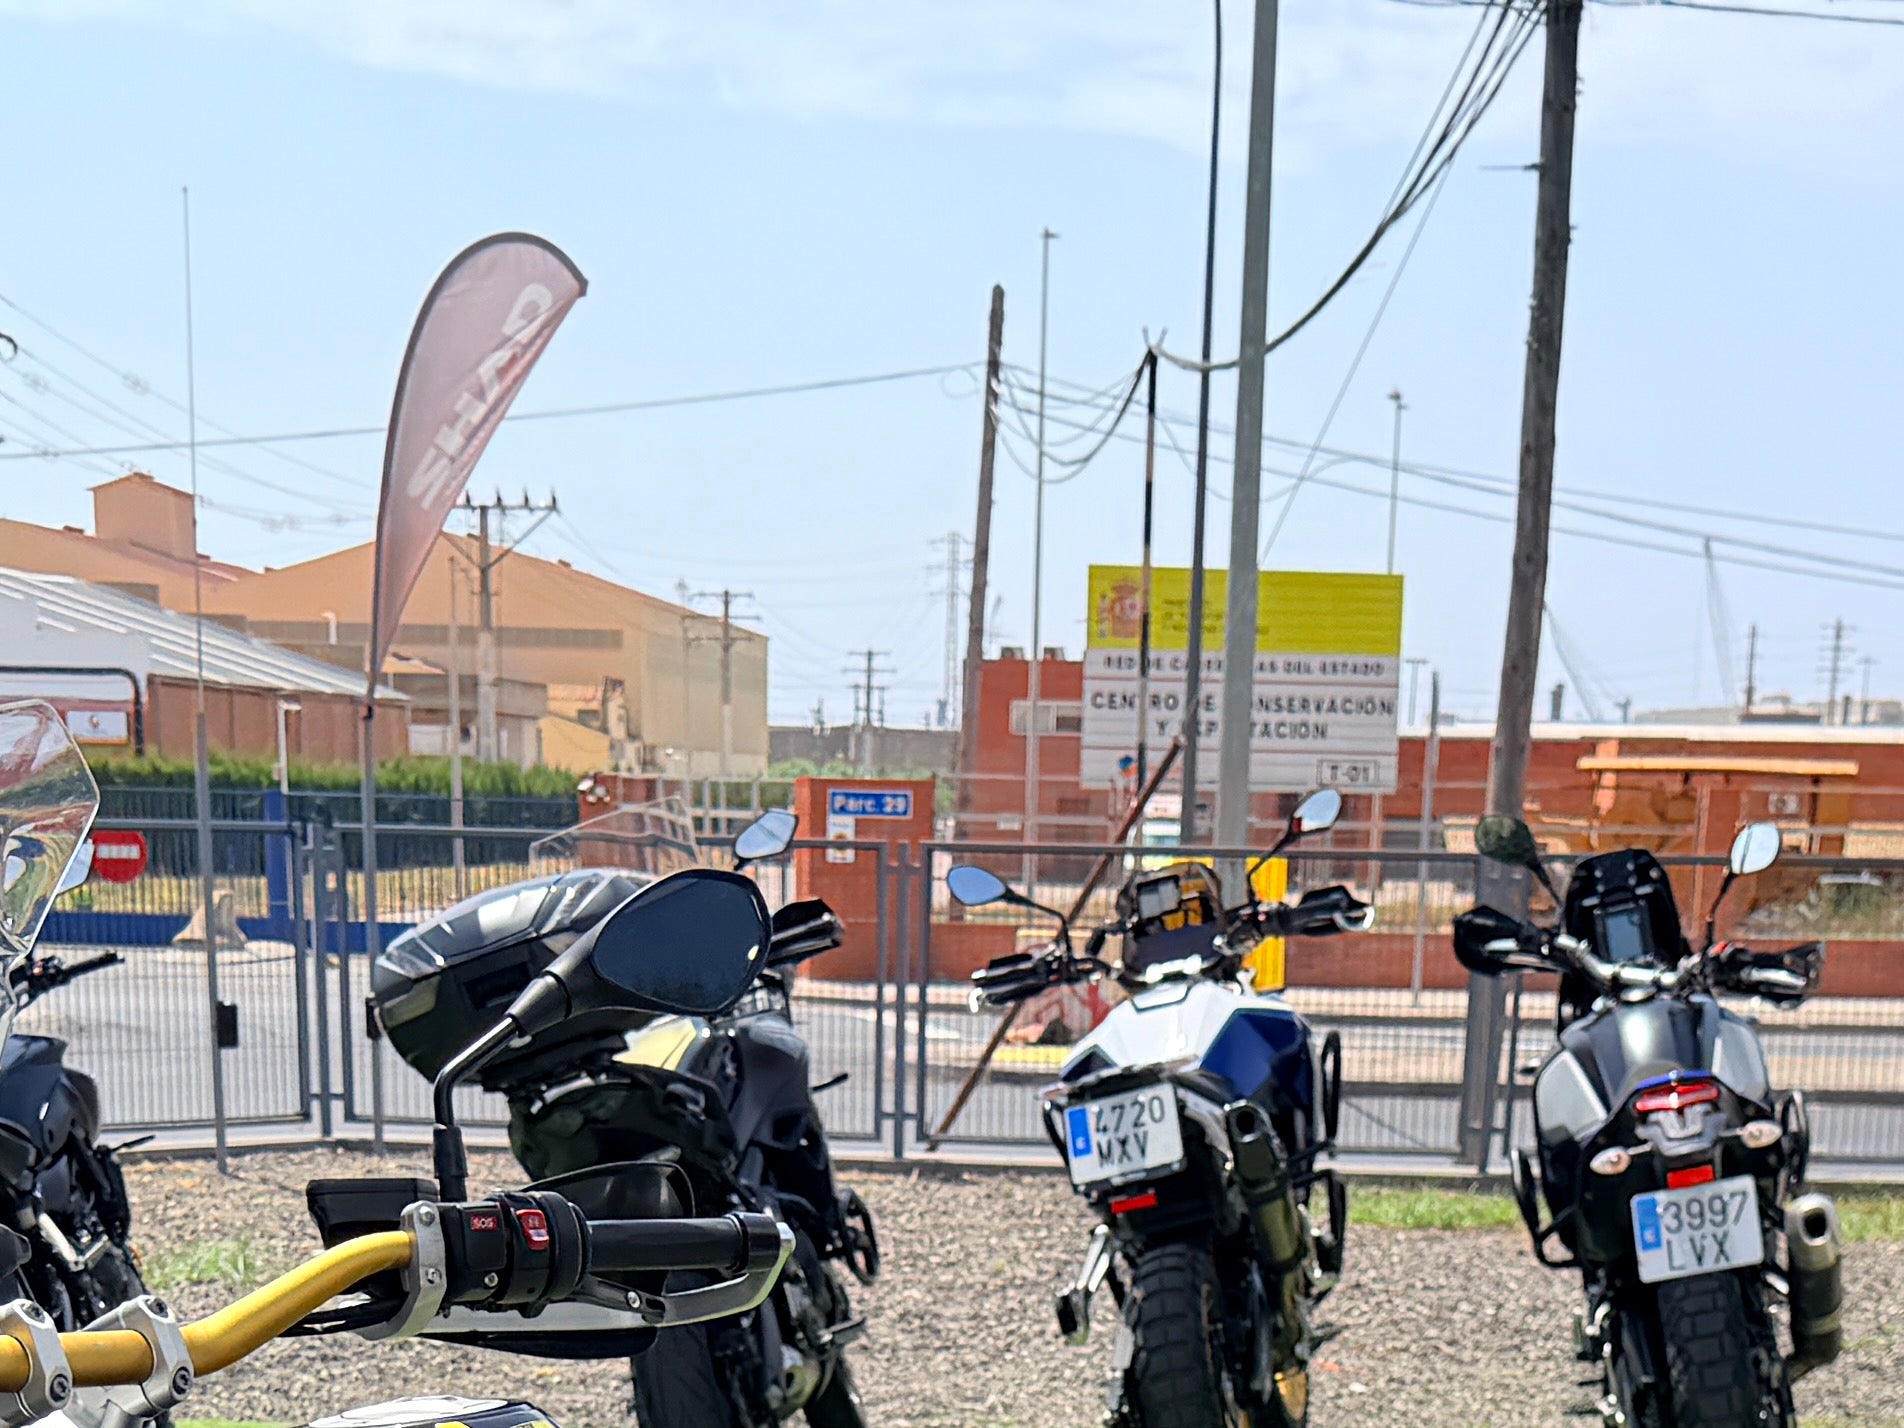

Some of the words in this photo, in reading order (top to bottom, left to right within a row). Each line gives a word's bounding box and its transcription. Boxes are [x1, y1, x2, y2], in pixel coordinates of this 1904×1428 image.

[1090, 692, 1179, 711] CENRO
[1097, 1130, 1149, 1168] MXV
[1663, 1191, 1749, 1234] 3997
[1666, 1229, 1731, 1272] LVX
